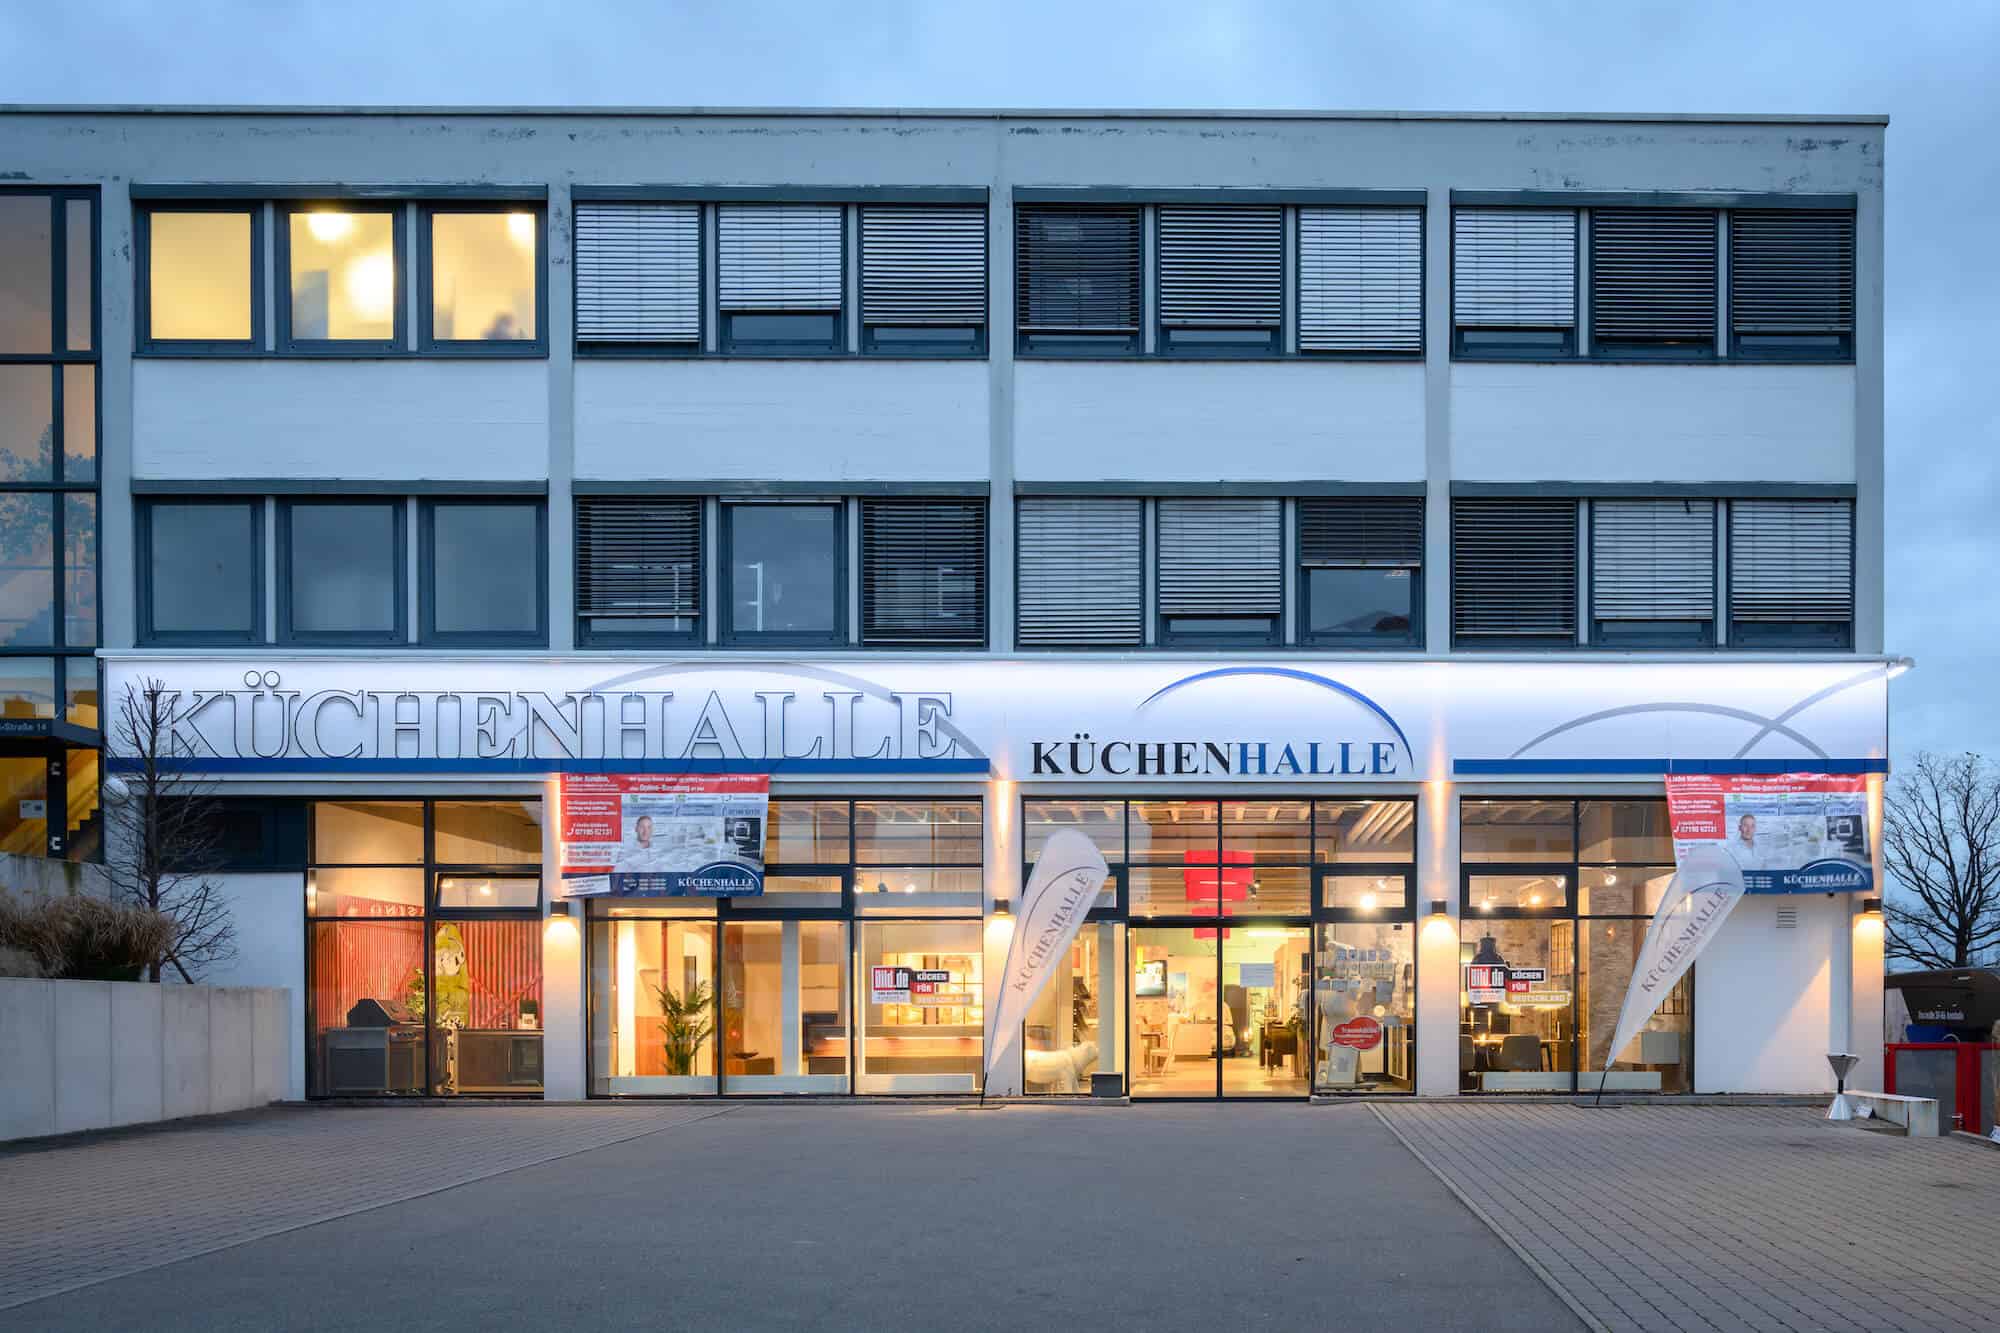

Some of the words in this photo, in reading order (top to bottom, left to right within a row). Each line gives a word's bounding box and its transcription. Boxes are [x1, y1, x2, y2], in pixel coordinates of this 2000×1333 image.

[144, 670, 957, 759] KÜCHENHALLE
[1032, 733, 1397, 776] KÜCHENHALLE
[677, 876, 755, 887] KÜCHENHALLE
[1783, 873, 1861, 885] KÜCHENHALLE
[1641, 888, 1729, 993] KÜCHENHALLE
[916, 971, 947, 981] KÜCHEN
[1511, 970, 1542, 980] KÜCHEN
[916, 982, 932, 992] FÜR
[1511, 981, 1527, 991] FÜR
